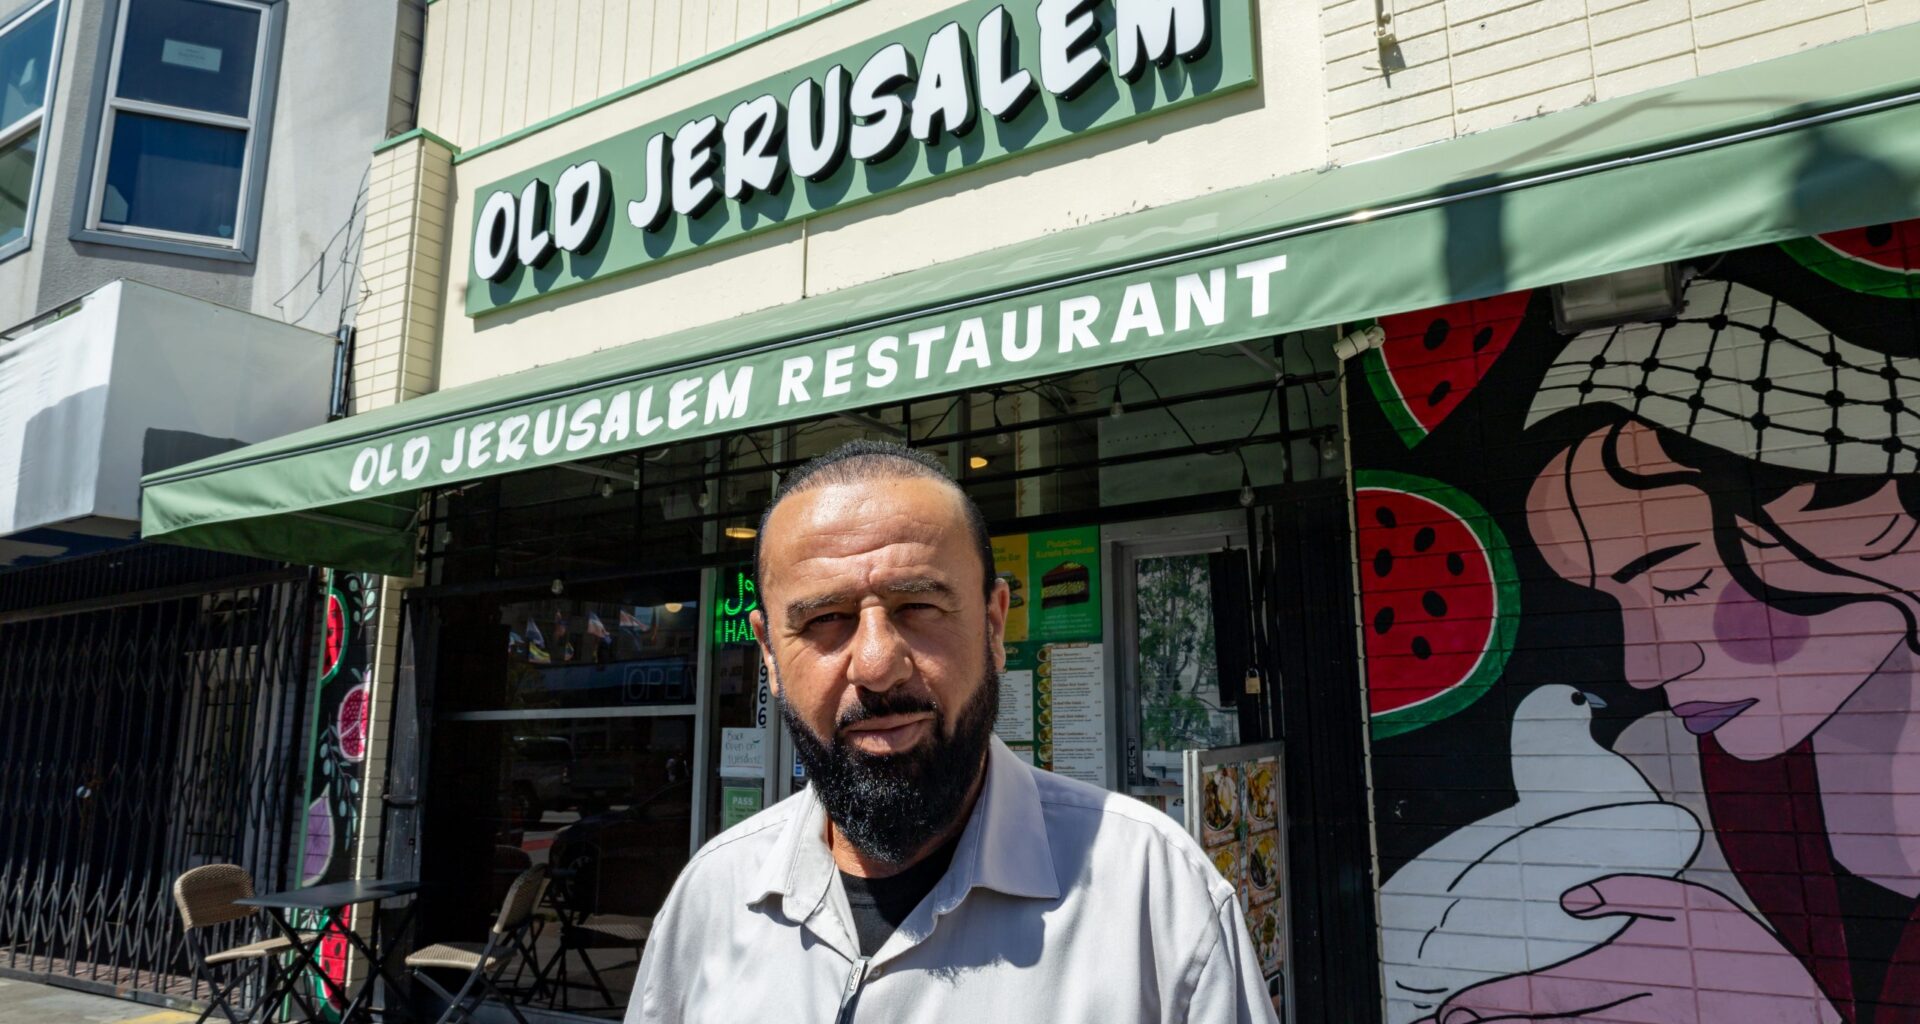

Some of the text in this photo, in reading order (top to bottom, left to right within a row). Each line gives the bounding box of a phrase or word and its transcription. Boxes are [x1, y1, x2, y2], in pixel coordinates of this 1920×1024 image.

[473, 0, 1211, 283] OLD JERUSALEM
[349, 254, 1287, 493] OLD JERUSALEM RESTAURANT
[732, 796, 753, 806] PASS
[1128, 741, 1136, 775] PUSH
